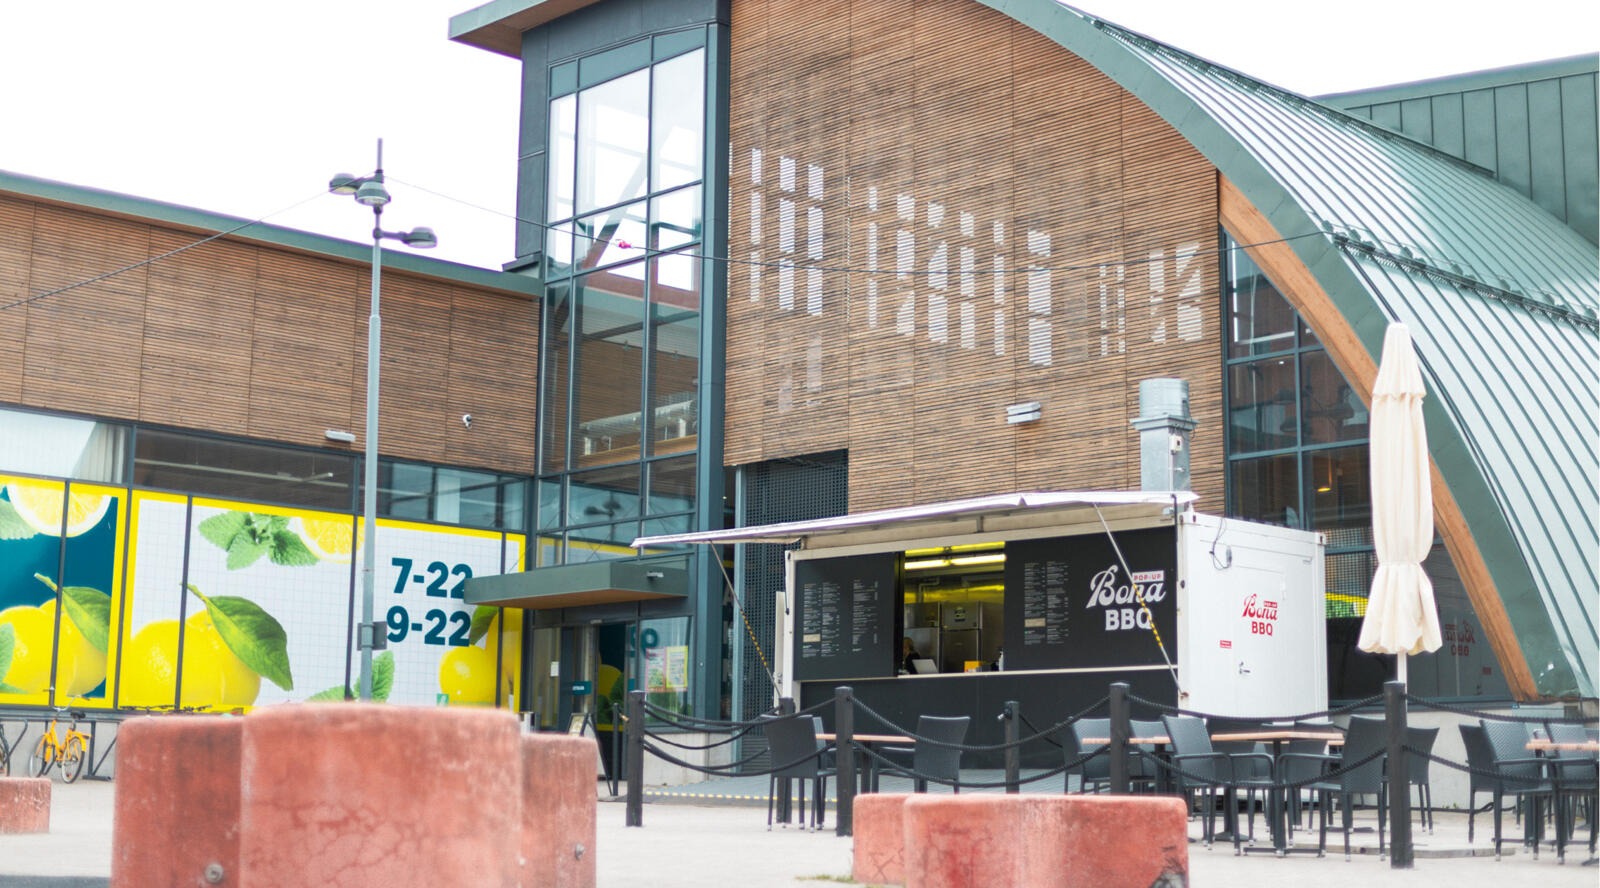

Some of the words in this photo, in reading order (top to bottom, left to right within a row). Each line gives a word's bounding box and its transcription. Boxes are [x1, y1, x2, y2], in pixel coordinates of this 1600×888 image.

[391, 557, 473, 600] 7-22
[1086, 564, 1166, 608] Bona
[1133, 573, 1162, 581] POP-UP
[1105, 607, 1152, 631] BBQ
[1242, 593, 1278, 621] Bona
[386, 605, 471, 647] 9-22
[1251, 621, 1273, 637] BBQ
